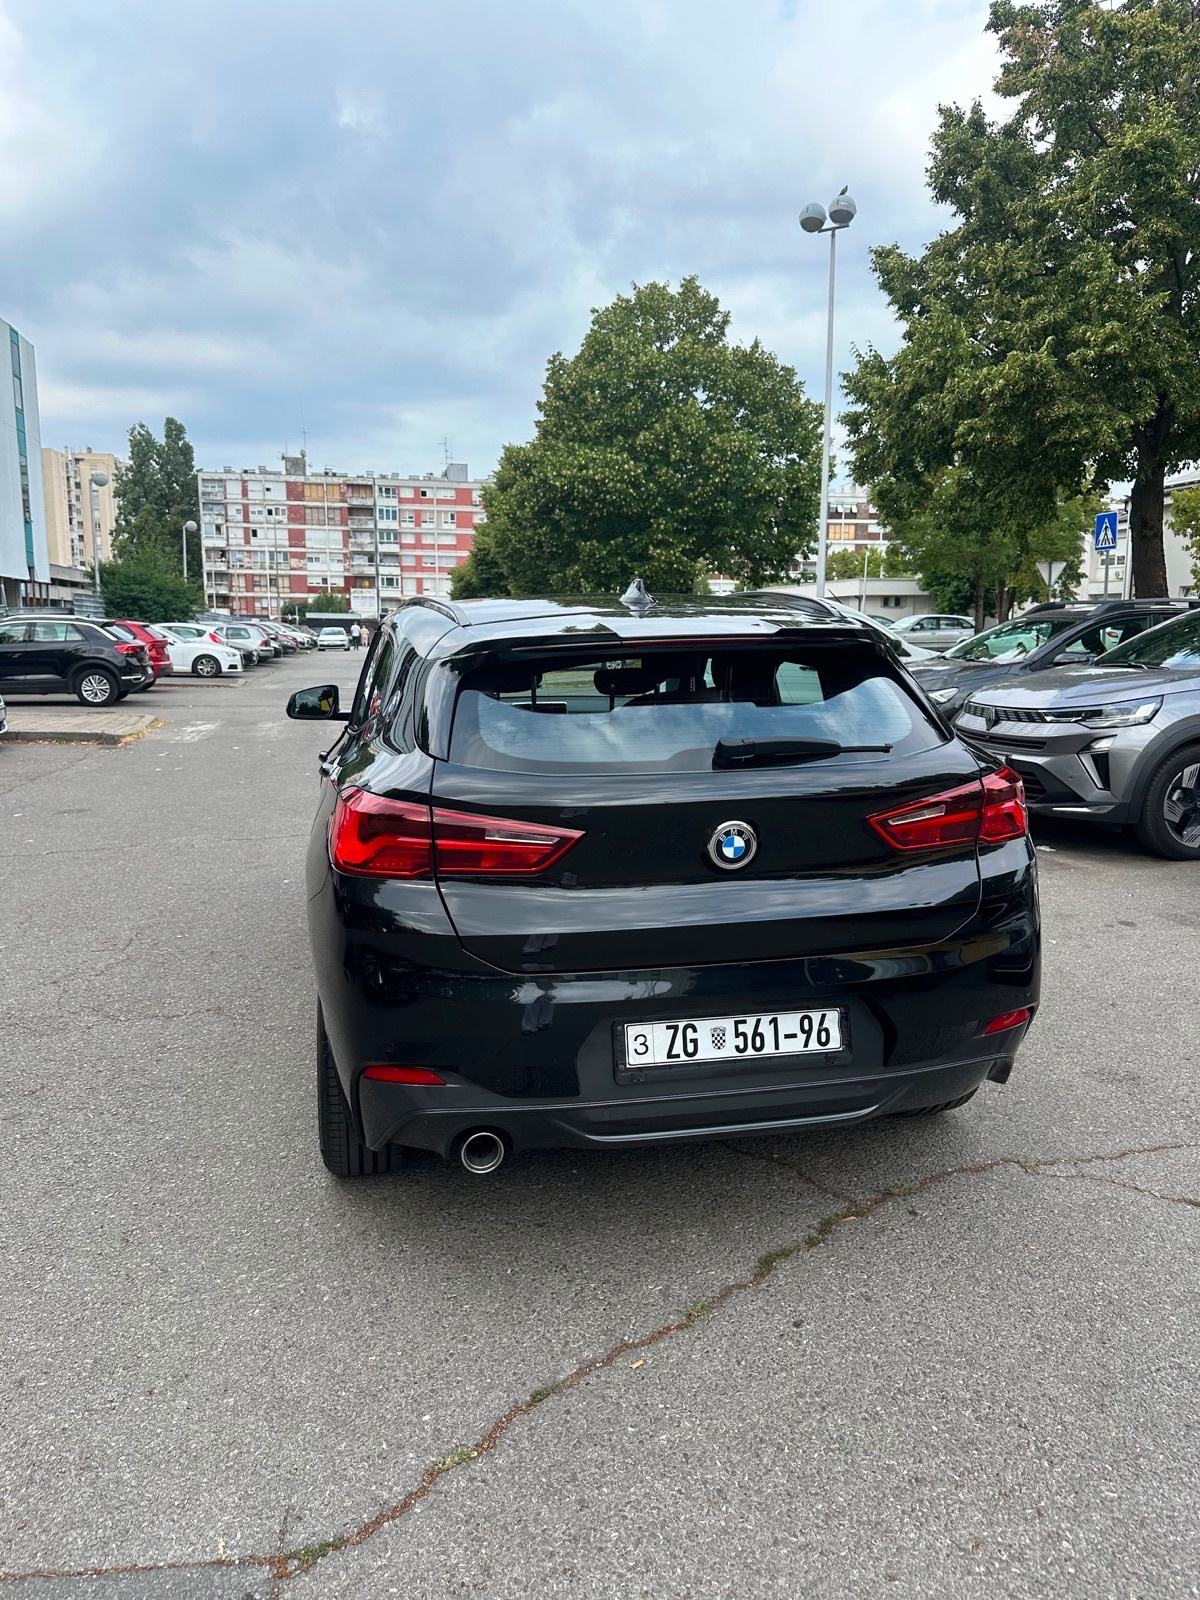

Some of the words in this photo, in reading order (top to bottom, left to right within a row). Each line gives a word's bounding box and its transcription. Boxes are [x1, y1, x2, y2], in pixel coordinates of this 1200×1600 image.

[719, 828, 749, 842] BMW
[633, 1034, 649, 1056] 3
[665, 1023, 699, 1060] ZG
[734, 1013, 831, 1054] 561-96
